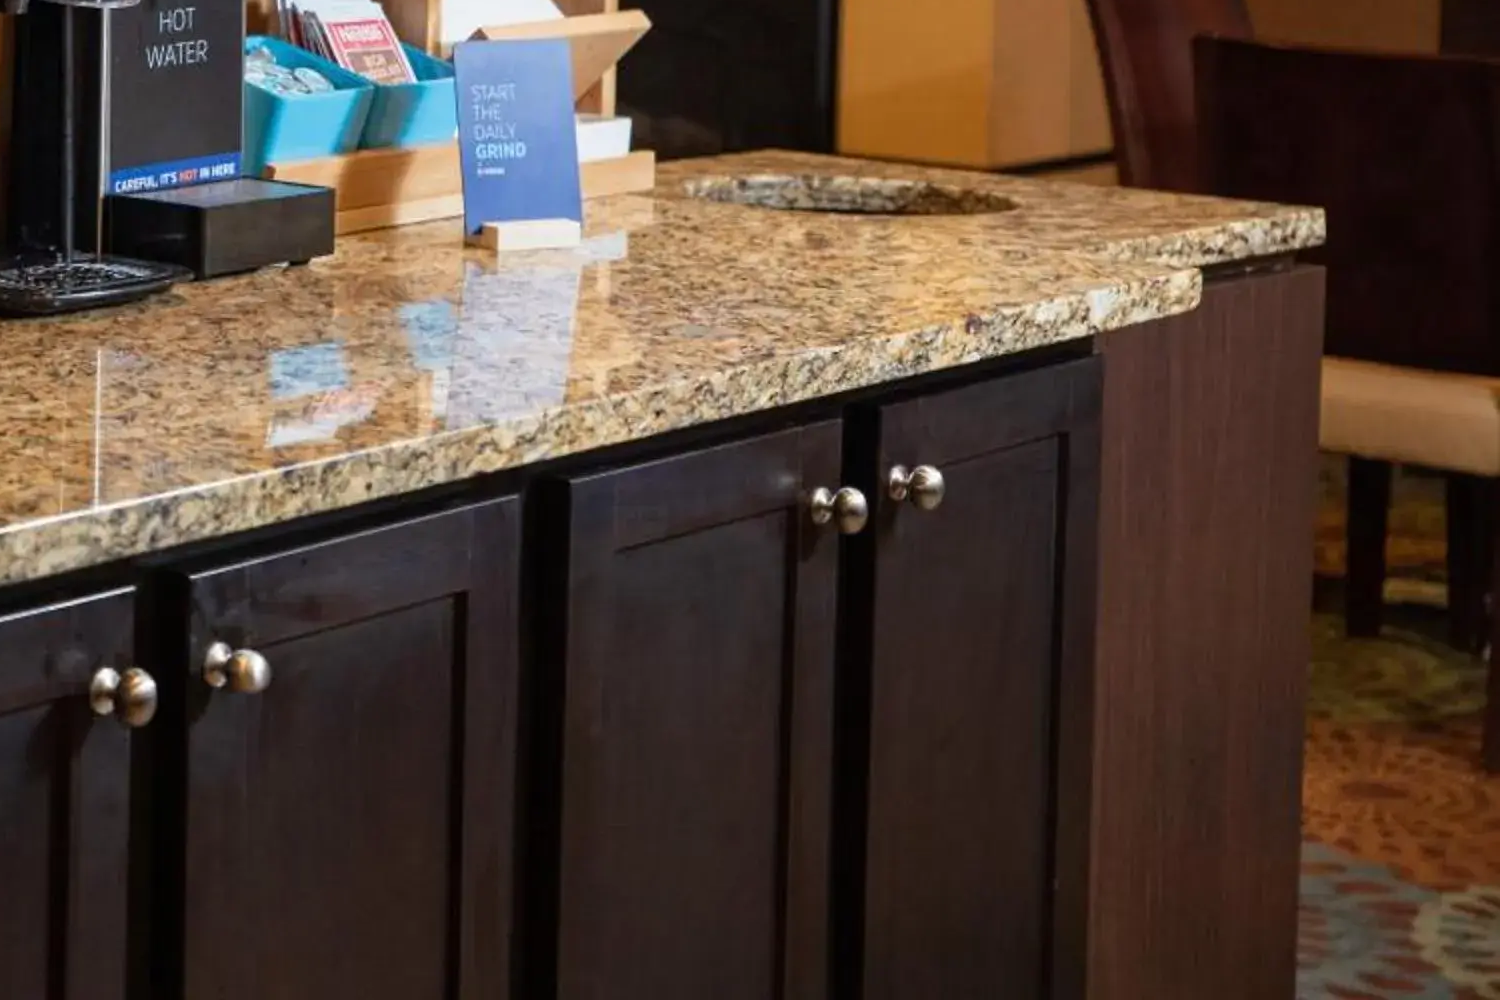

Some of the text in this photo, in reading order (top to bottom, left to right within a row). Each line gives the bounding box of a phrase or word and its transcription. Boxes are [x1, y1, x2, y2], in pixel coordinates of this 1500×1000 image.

[159, 7, 196, 34] HOT
[145, 39, 209, 69] WATER
[470, 83, 517, 102] START
[472, 104, 501, 121] THE
[474, 121, 517, 141] DAILY
[475, 141, 527, 160] GRIND
[179, 168, 199, 183] HOT
[200, 167, 210, 179] IN
